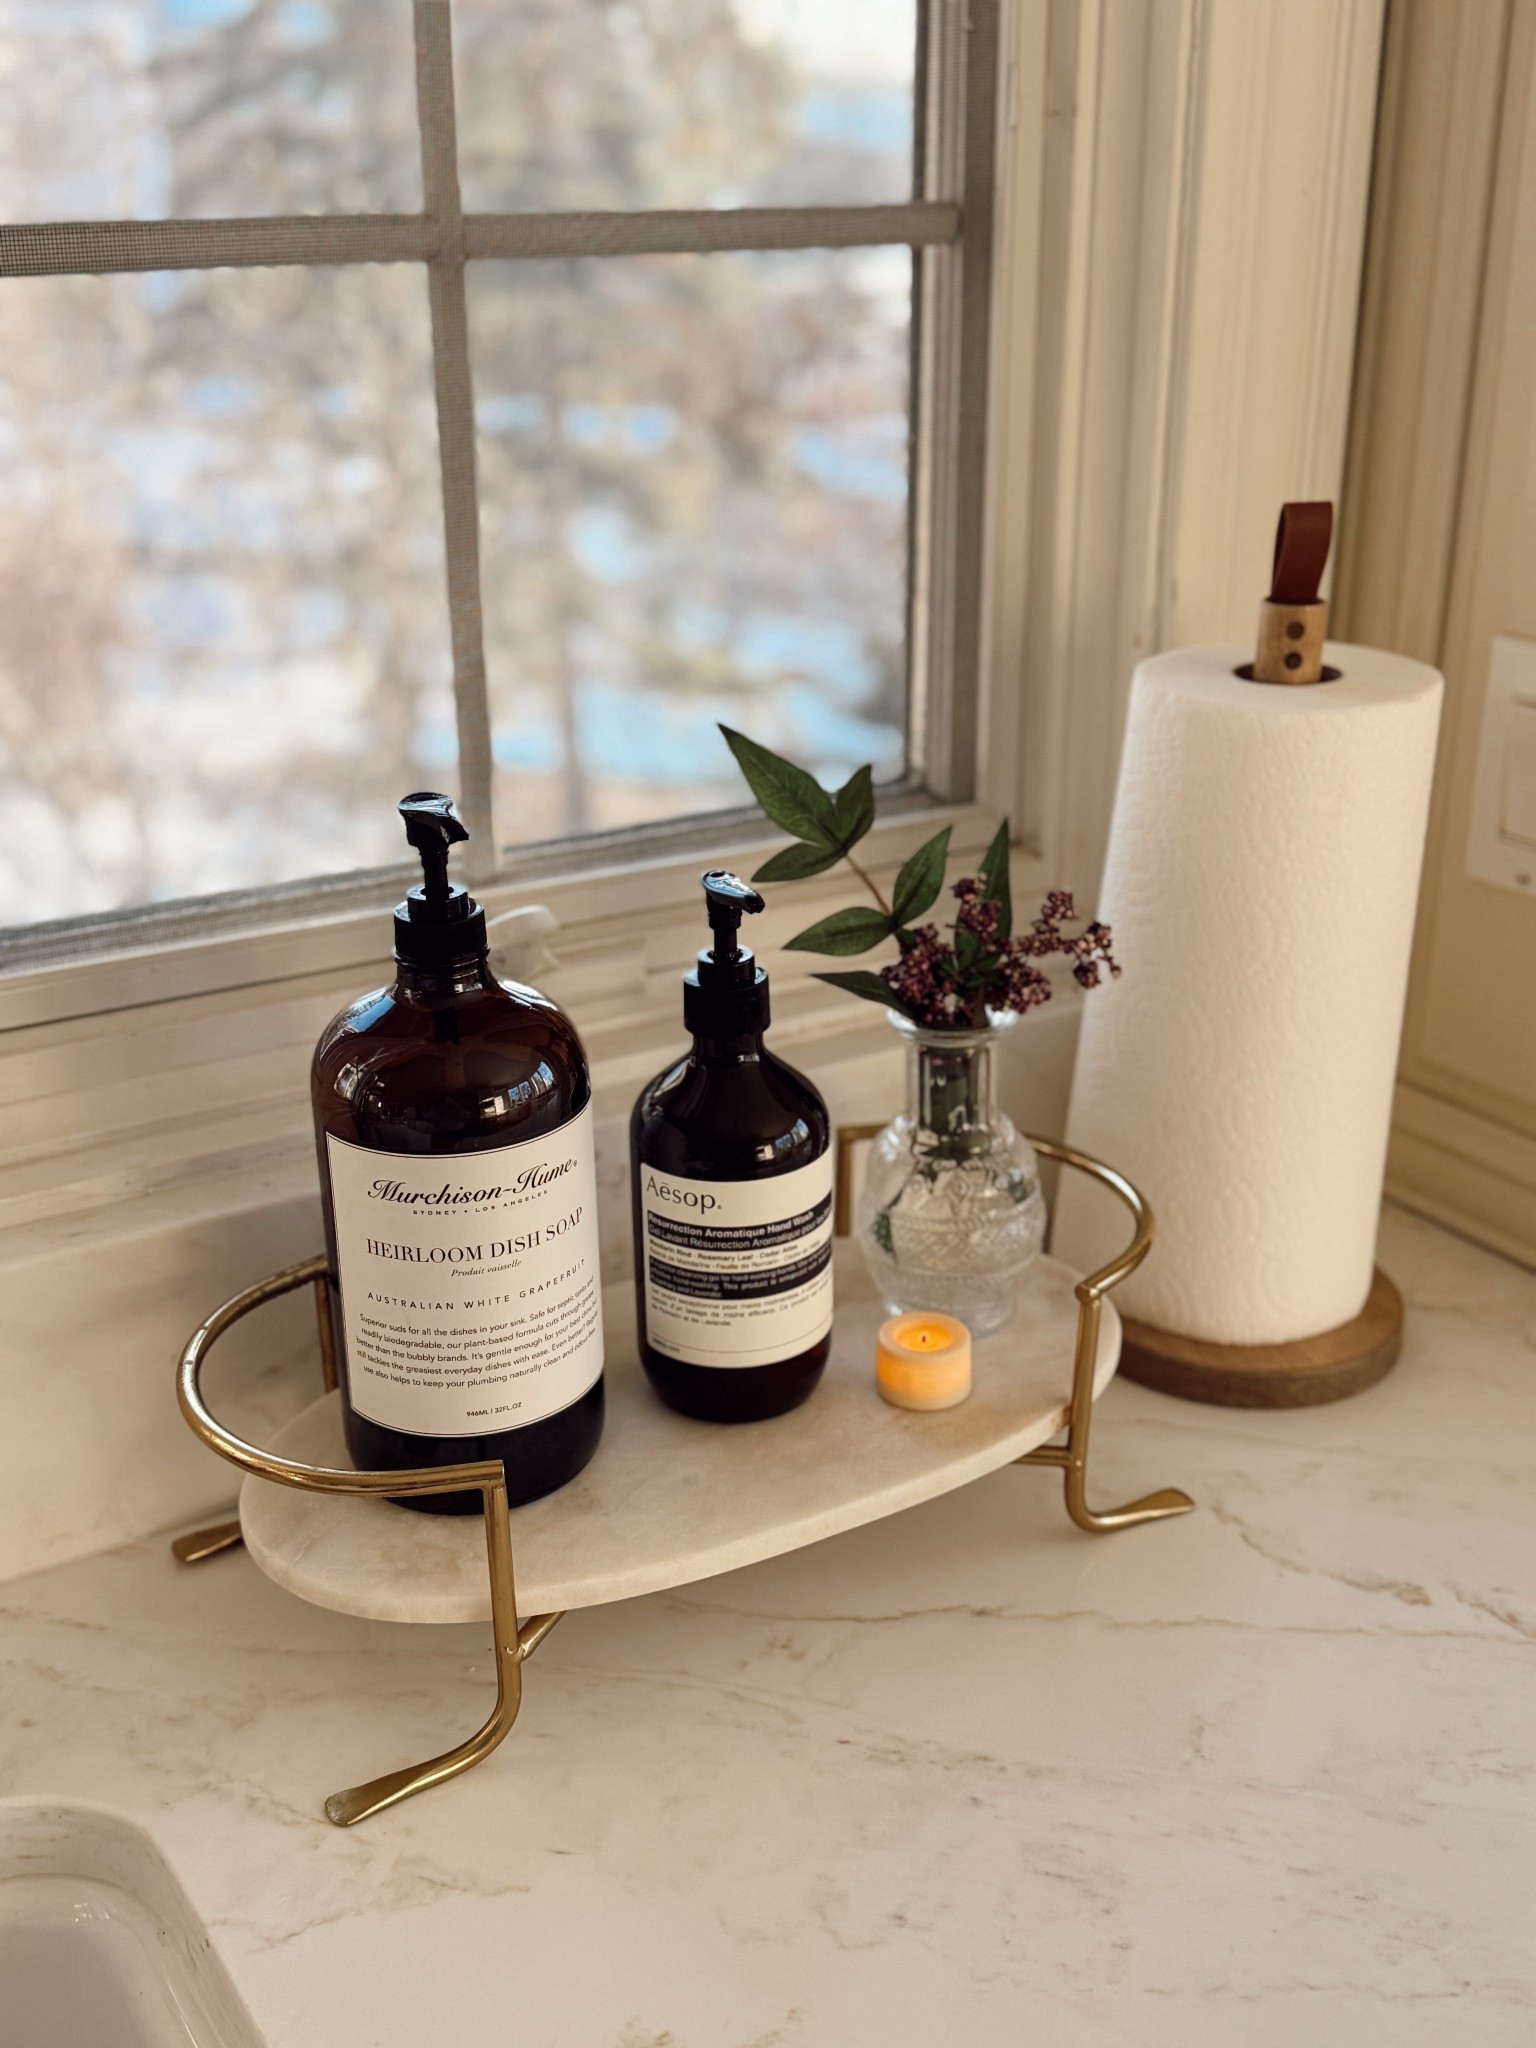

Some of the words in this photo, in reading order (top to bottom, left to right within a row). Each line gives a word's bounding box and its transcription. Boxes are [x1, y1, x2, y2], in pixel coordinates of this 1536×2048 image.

[475, 1205, 496, 1213] LOS
[502, 1189, 548, 1208] ANGELES
[365, 1238, 484, 1263] HEIRLOOM
[488, 1230, 541, 1259] DISH
[545, 1206, 583, 1242] SOAP
[648, 1212, 703, 1236] Resurrection
[705, 1228, 765, 1240] Aromatique
[767, 1220, 791, 1233] Hand
[792, 1211, 814, 1227] Wash
[661, 1230, 688, 1245] Lavant
[690, 1237, 750, 1250] Résurrection
[752, 1229, 801, 1248] Aromatique
[451, 1266, 485, 1277] Produit
[487, 1259, 522, 1273] vaisselle
[698, 1252, 735, 1263] Rosemary
[367, 1292, 454, 1310] AUSTRALIAN
[463, 1294, 511, 1309] WHITE
[519, 1258, 585, 1299] GRAPEFRUIT
[359, 1313, 387, 1329] Superior
[389, 1325, 407, 1333] suds
[408, 1326, 419, 1335] for
[433, 1328, 448, 1336] the
[449, 1328, 478, 1336] dishes
[479, 1325, 488, 1333] in
[489, 1322, 508, 1334] your
[510, 1316, 527, 1328] sink.
[529, 1310, 545, 1321] Safe
[546, 1305, 556, 1315] for
[361, 1328, 382, 1342] readily
[383, 1334, 445, 1350] biodegradable,
[463, 1333, 514, 1350] plant-based
[515, 1324, 544, 1339] formula
[545, 1317, 560, 1328] cuts
[560, 1303, 582, 1321] through
[375, 1344, 391, 1355] than
[392, 1349, 405, 1358] the
[406, 1351, 435, 1363] bubbly
[437, 1353, 469, 1362] brands.
[485, 1347, 512, 1361] gentle
[514, 1337, 543, 1352] enough
[544, 1333, 554, 1342] for
[554, 1324, 569, 1338] your
[569, 1316, 581, 1328] best
[363, 1365, 374, 1375] use
[375, 1369, 389, 1379] also
[390, 1373, 411, 1385] helps
[412, 1378, 421, 1386] to
[422, 1378, 444, 1389] keep
[445, 1381, 465, 1389] your
[467, 1375, 508, 1389] plumbing
[509, 1364, 542, 1380] naturally
[543, 1355, 561, 1368] clean
[562, 1346, 574, 1359] and
[367, 1354, 391, 1368] tackles
[391, 1362, 404, 1371] the
[405, 1365, 442, 1375] greasiest
[444, 1366, 483, 1376] everyday
[485, 1361, 512, 1372] dishes
[513, 1354, 530, 1365] with
[531, 1350, 550, 1360] ease.
[551, 1339, 567, 1351] Even
[466, 1409, 489, 1417] 946ML
